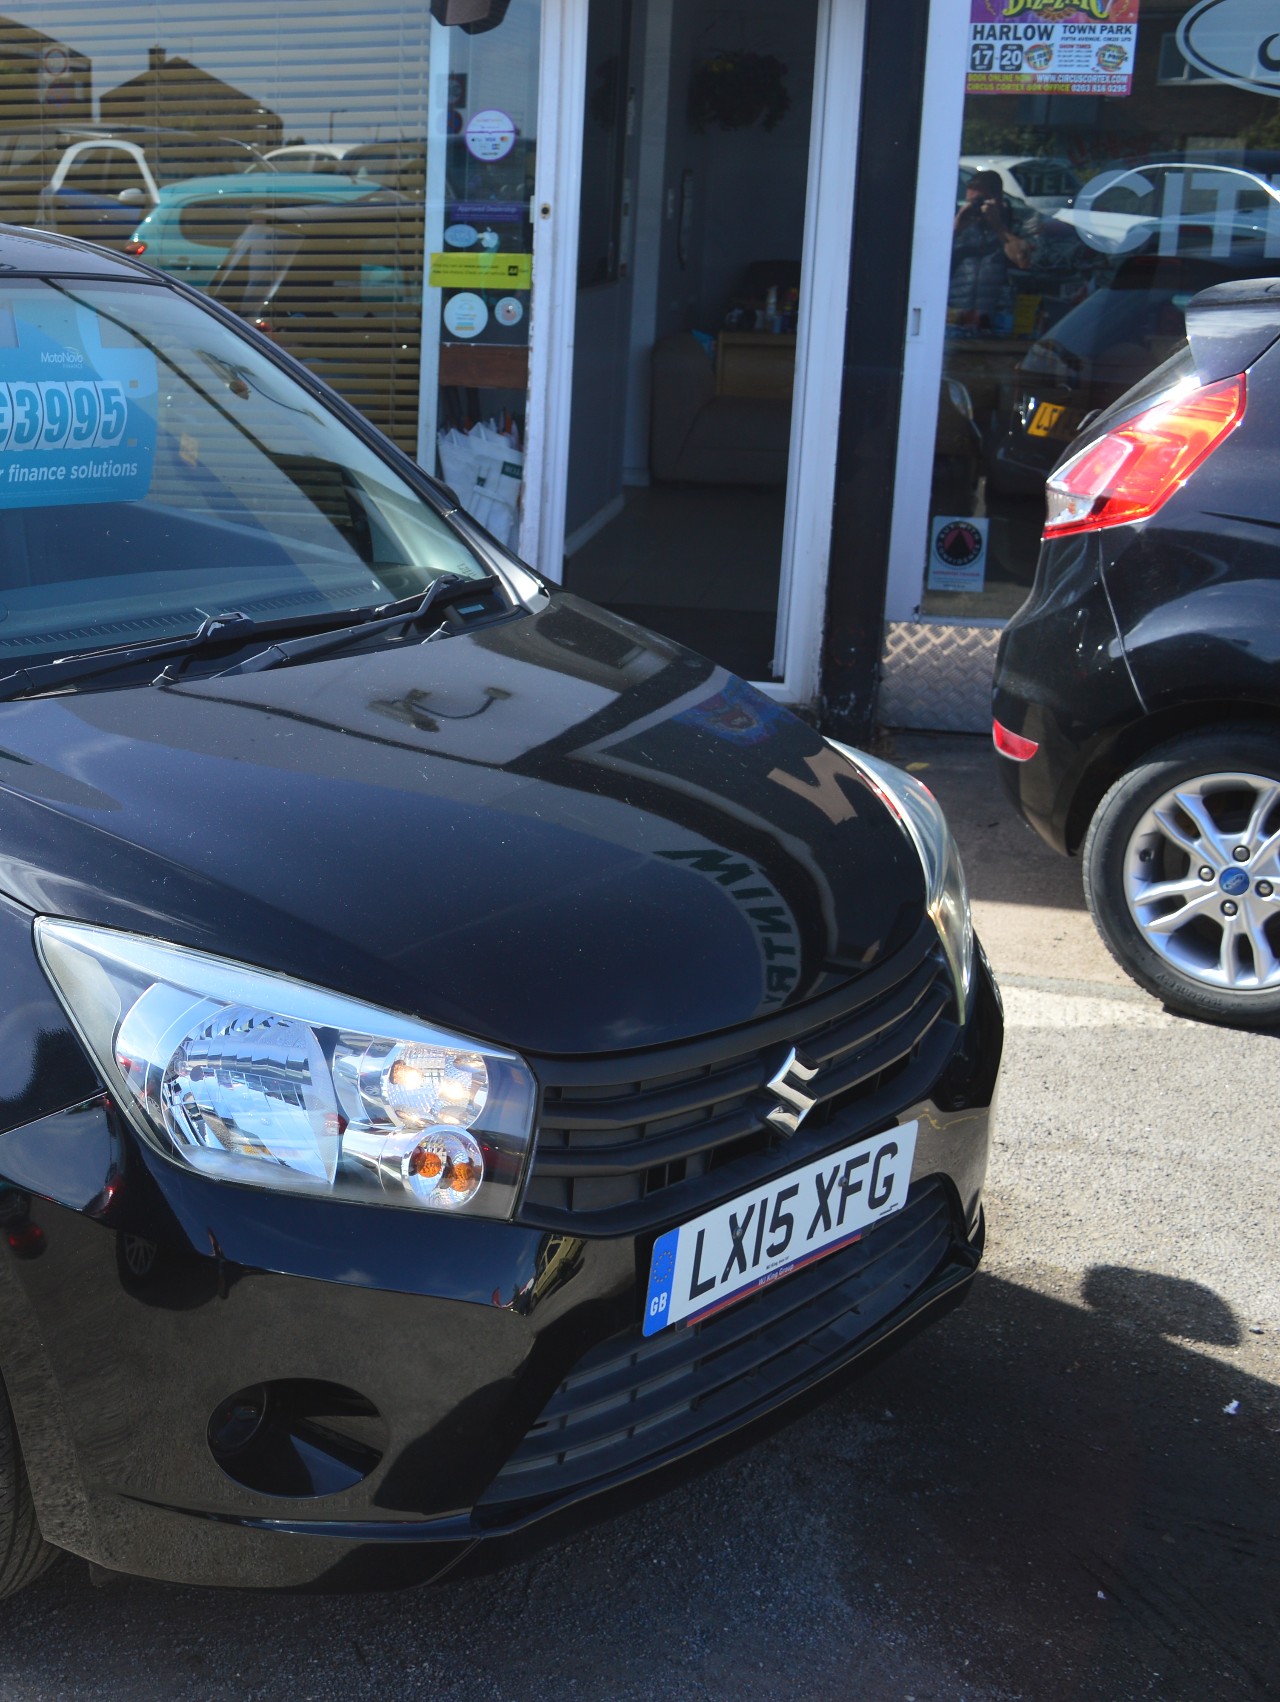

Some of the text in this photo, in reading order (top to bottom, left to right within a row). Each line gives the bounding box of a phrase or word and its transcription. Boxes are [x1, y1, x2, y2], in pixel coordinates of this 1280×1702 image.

[972, 24, 1055, 41] HARLOW
[1062, 25, 1132, 35] TOWN PARK
[972, 50, 993, 65] 17
[1001, 50, 1022, 66] 20
[41, 351, 84, 363] MotoNovo
[8, 463, 66, 483] finance
[70, 459, 138, 479] solutions
[688, 1141, 899, 1301] LX15 XFG
[650, 1292, 668, 1316] GB
